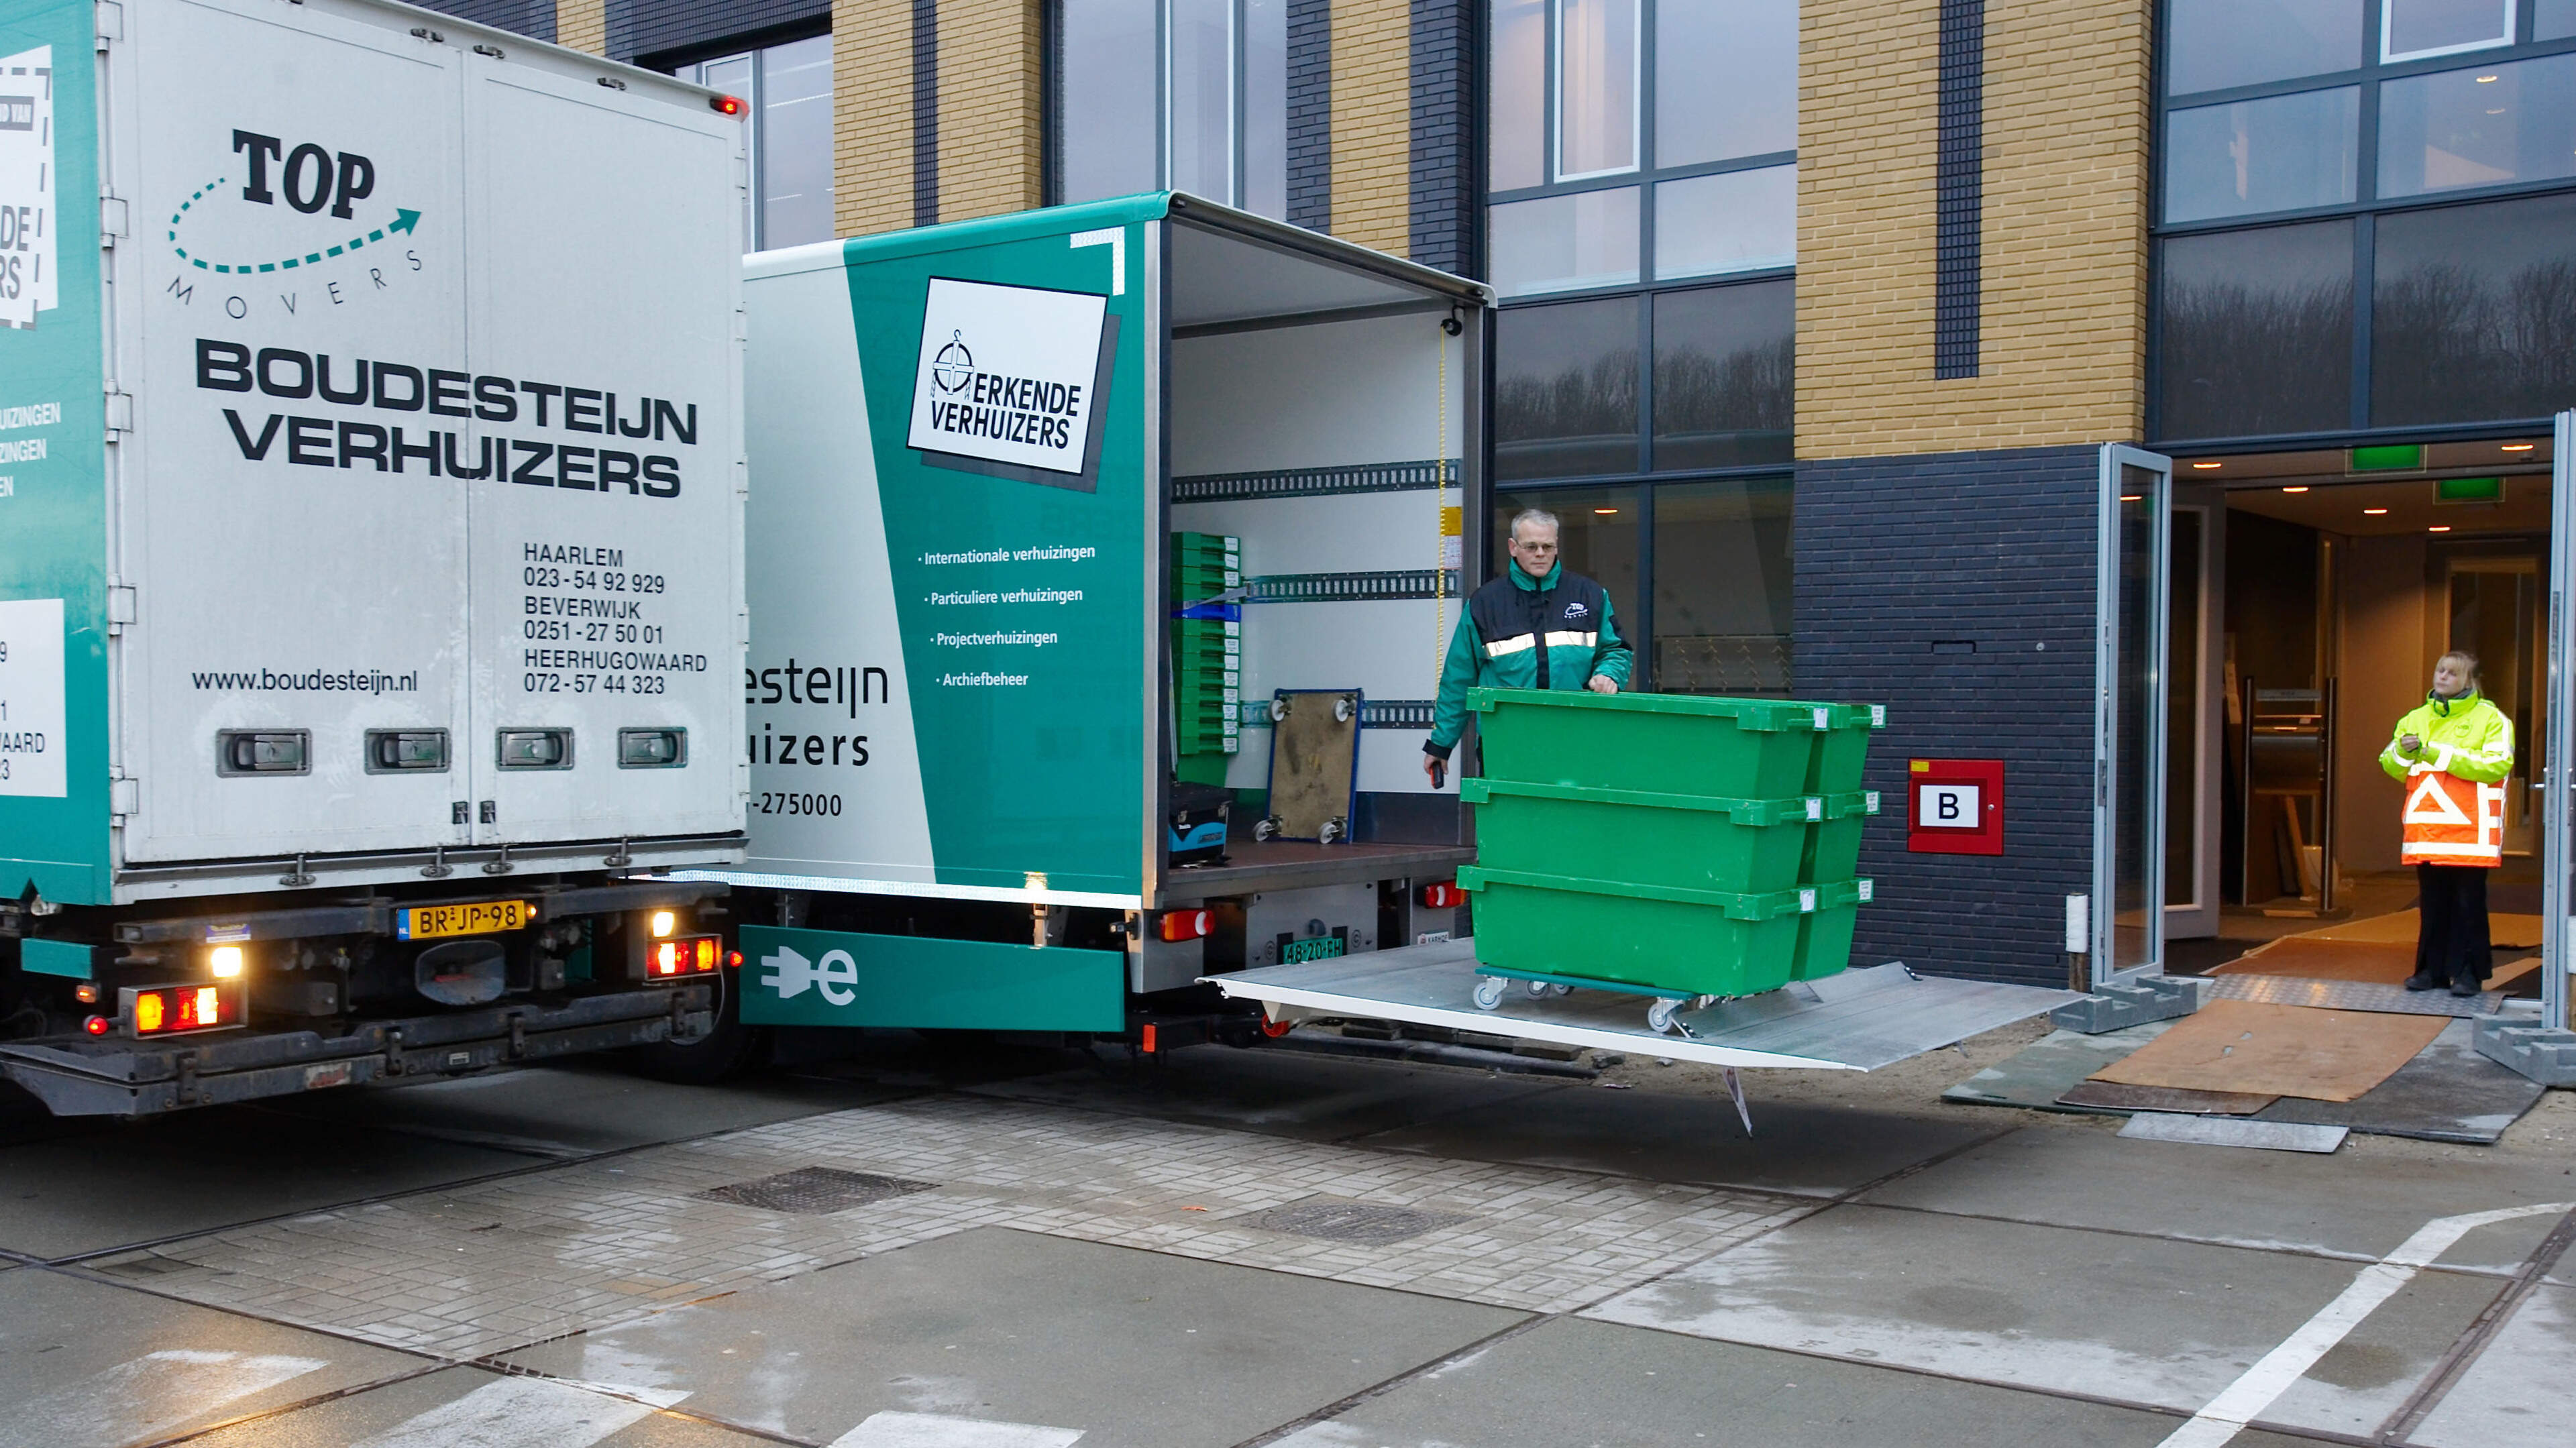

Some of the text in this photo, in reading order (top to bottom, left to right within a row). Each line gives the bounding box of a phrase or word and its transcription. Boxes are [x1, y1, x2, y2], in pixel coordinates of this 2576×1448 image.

[233, 129, 375, 220] TOP
[167, 249, 422, 319] MOVERS
[196, 338, 697, 444] BOUDESTEIJN
[973, 372, 1082, 417] ERKENDE
[932, 400, 1071, 449] VERHUIZERS
[222, 408, 681, 498] VERHUIZERS
[525, 543, 623, 567] HAARLEM
[924, 545, 1096, 565] Internationale verhuizingen
[604, 571, 626, 592] 92
[632, 573, 665, 594] 929
[525, 596, 641, 620] BEVERWIJK
[931, 588, 1083, 605] Particuliere verhuizingen
[615, 624, 637, 643] 50
[643, 625, 663, 644] 01
[937, 630, 1058, 649] Projectverhuizingen
[525, 649, 708, 672] HEERHUGOWAARD
[192, 667, 417, 696] www.boudesteijn.nl
[604, 675, 626, 693] 44
[632, 675, 665, 695] 323
[943, 671, 1029, 687] Archiefbeheer
[0, 732, 45, 753] AARD
[1939, 793, 1960, 820] B
